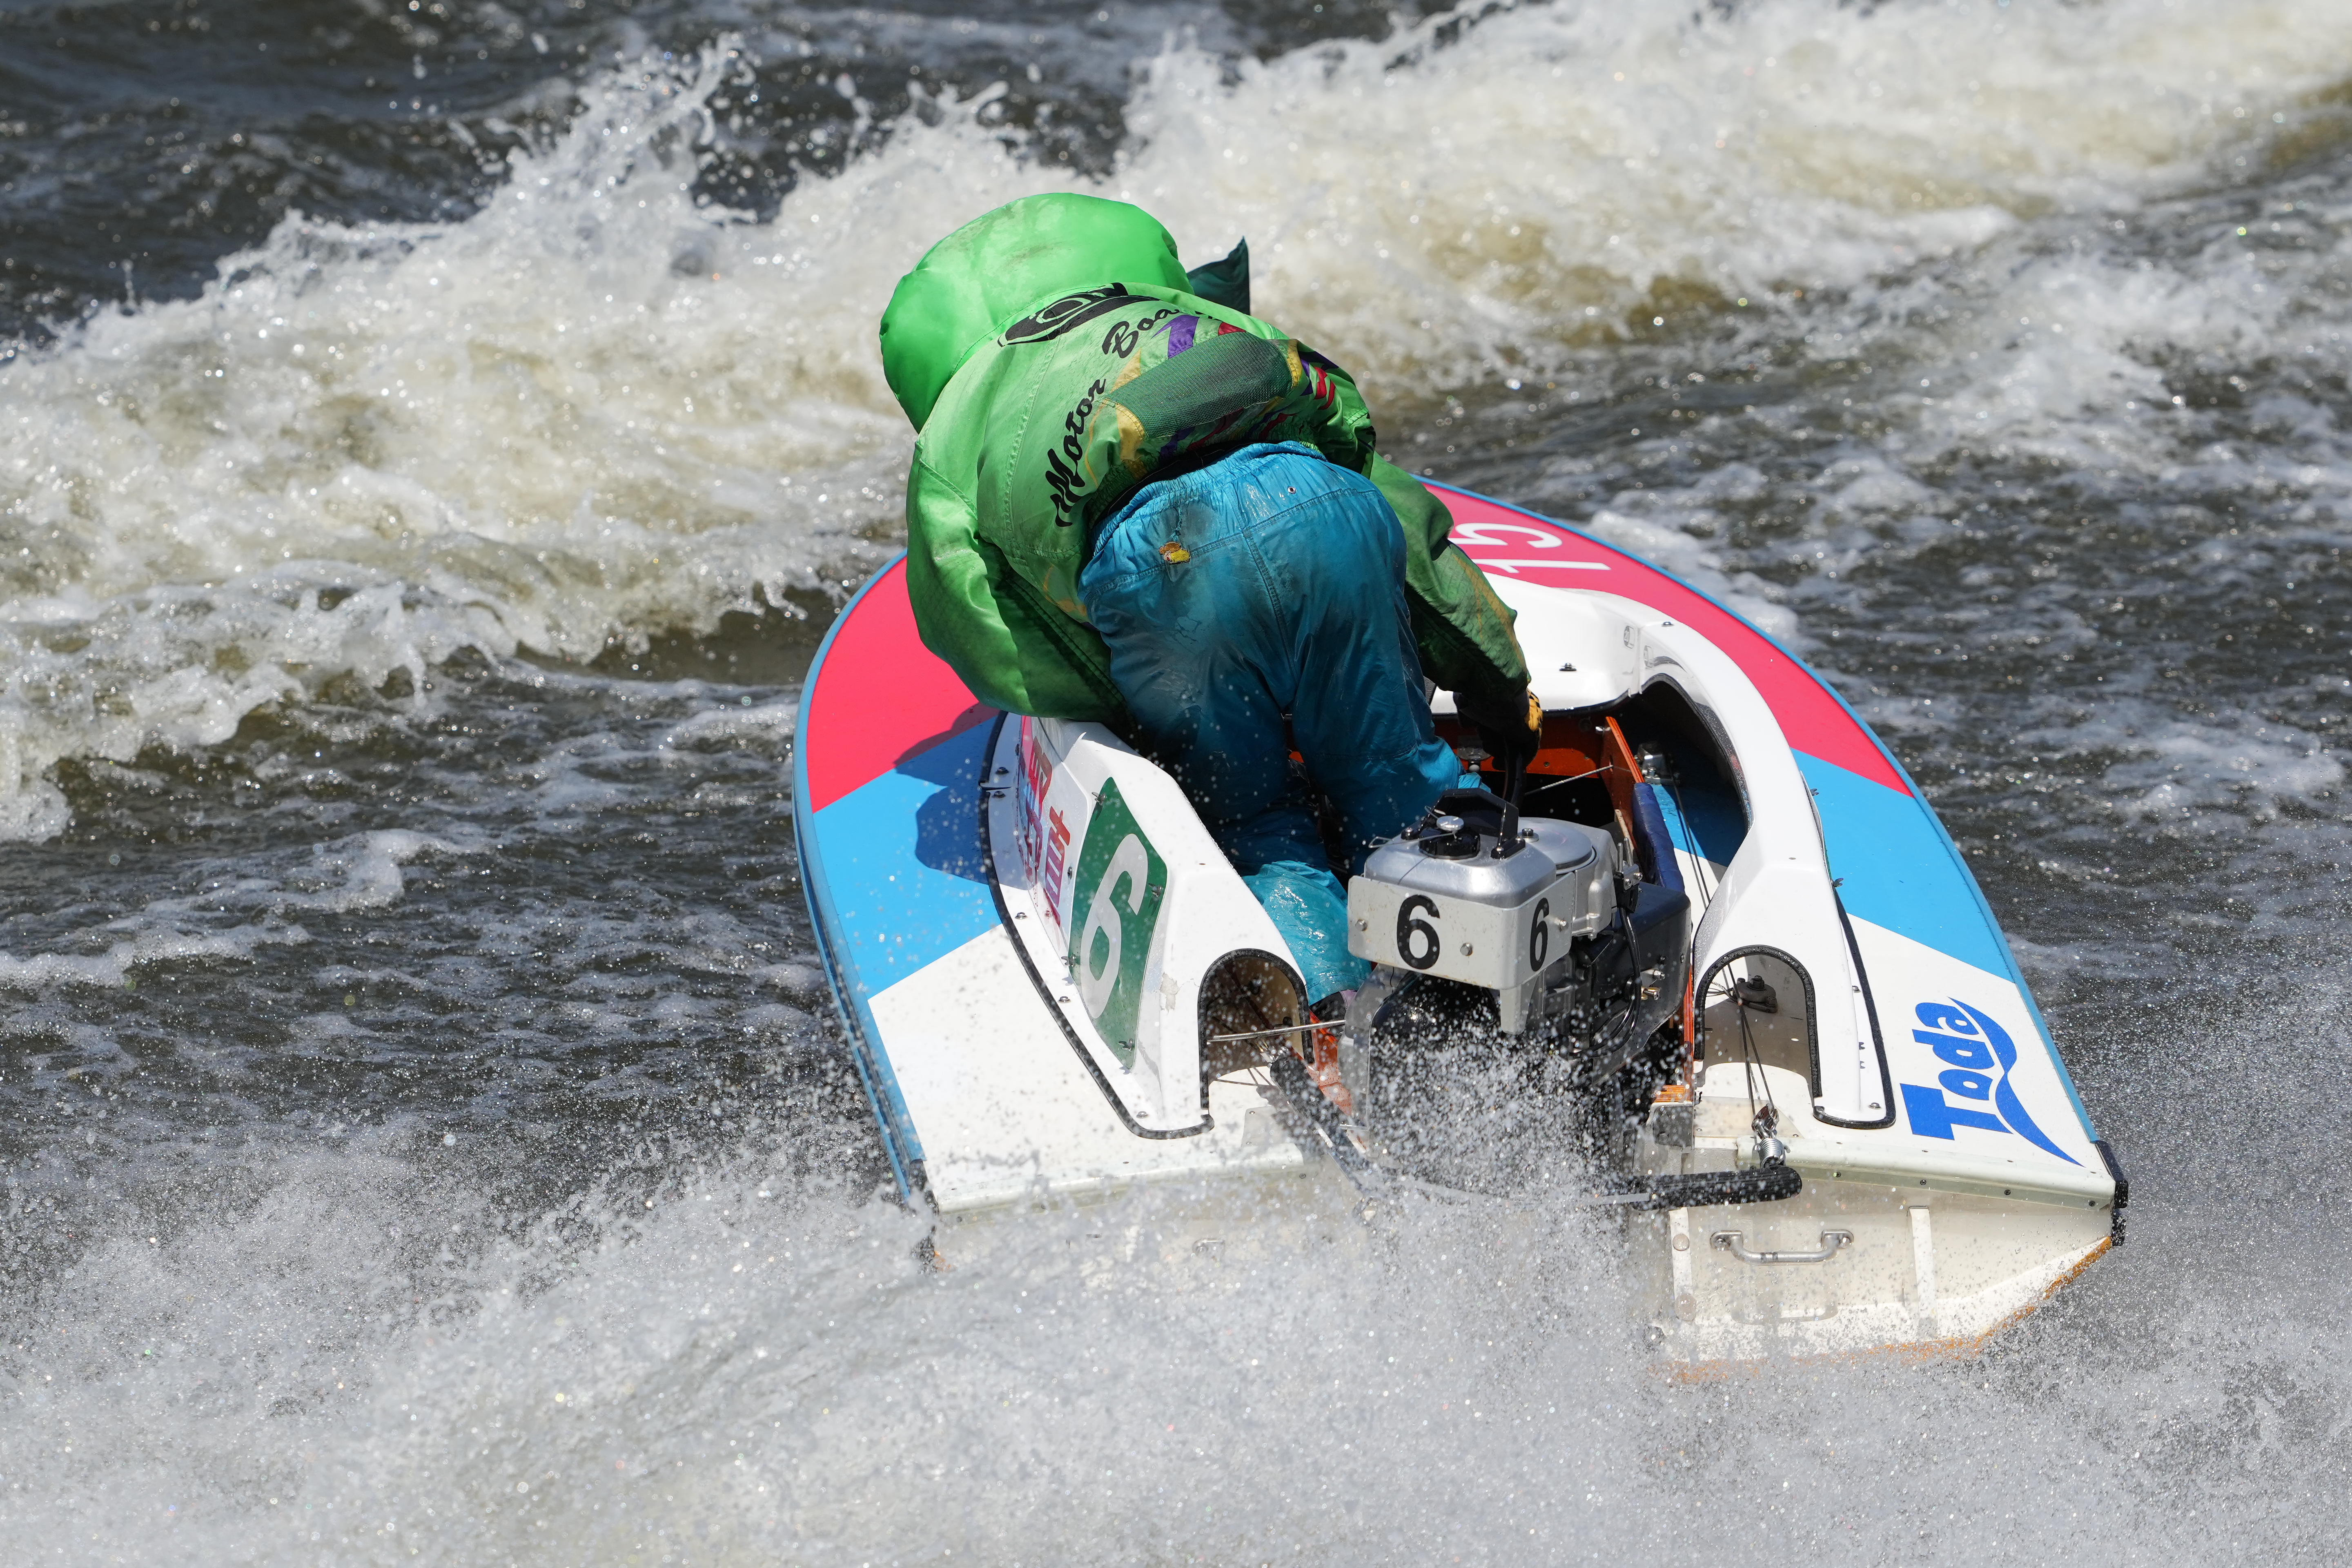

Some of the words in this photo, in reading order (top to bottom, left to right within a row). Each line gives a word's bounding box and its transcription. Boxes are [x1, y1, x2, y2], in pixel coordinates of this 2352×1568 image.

[1045, 378, 1106, 528] Motor
[1102, 308, 1181, 358] Boa
[1080, 833, 1148, 1018] 6
[1396, 895, 1440, 969] 6
[1529, 898, 1550, 971] 6
[1900, 1002, 2014, 1140] Toda
